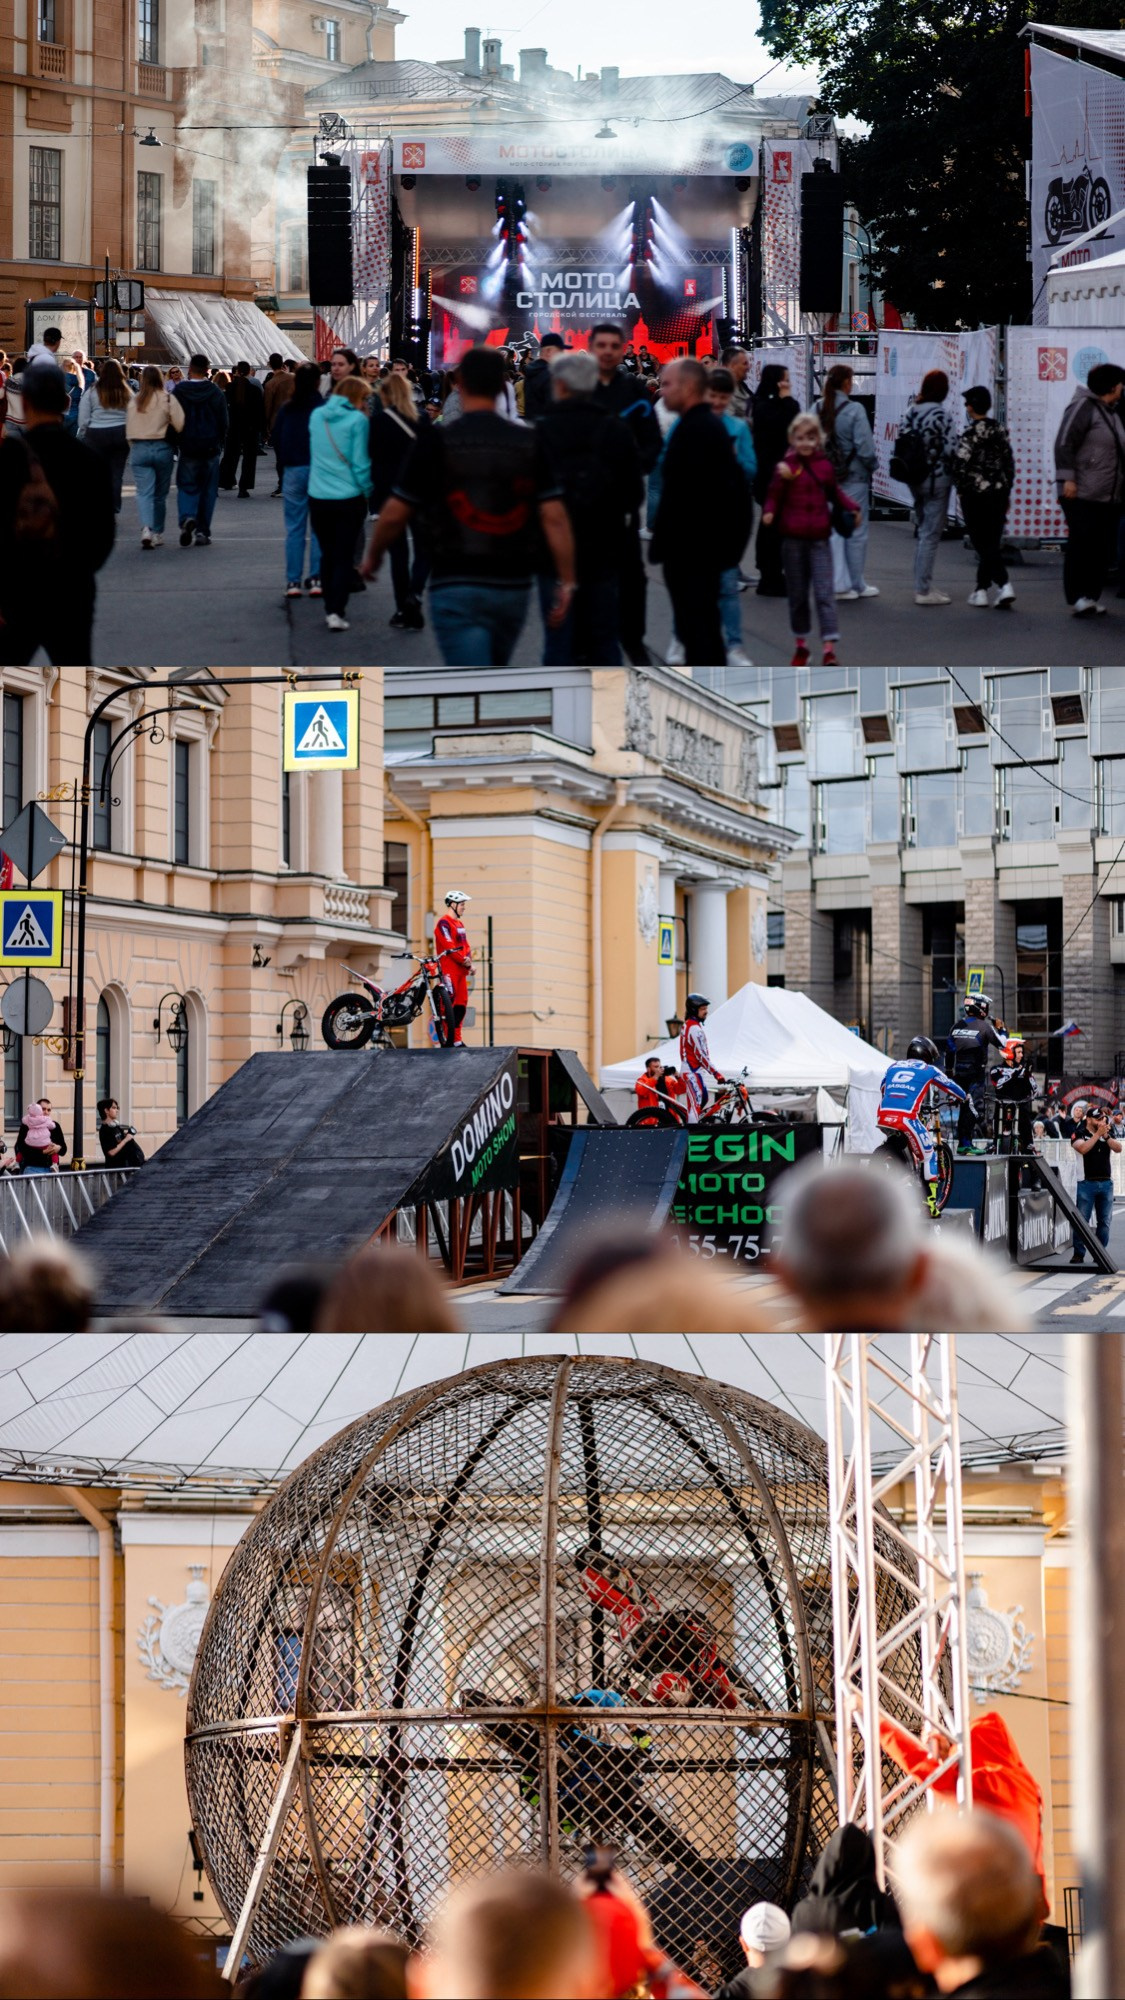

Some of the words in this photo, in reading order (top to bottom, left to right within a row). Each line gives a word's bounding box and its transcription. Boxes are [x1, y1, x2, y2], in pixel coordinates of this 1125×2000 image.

[499, 145, 648, 160] МОТОСТОЛИЦА
[541, 272, 615, 289] МОТО
[516, 291, 641, 310] СТОЛИЦА
[451, 1072, 513, 1182] DOMINO
[471, 1147, 493, 1187] MOTO
[493, 1113, 516, 1155] SHOW
[688, 1130, 795, 1162] EGIN
